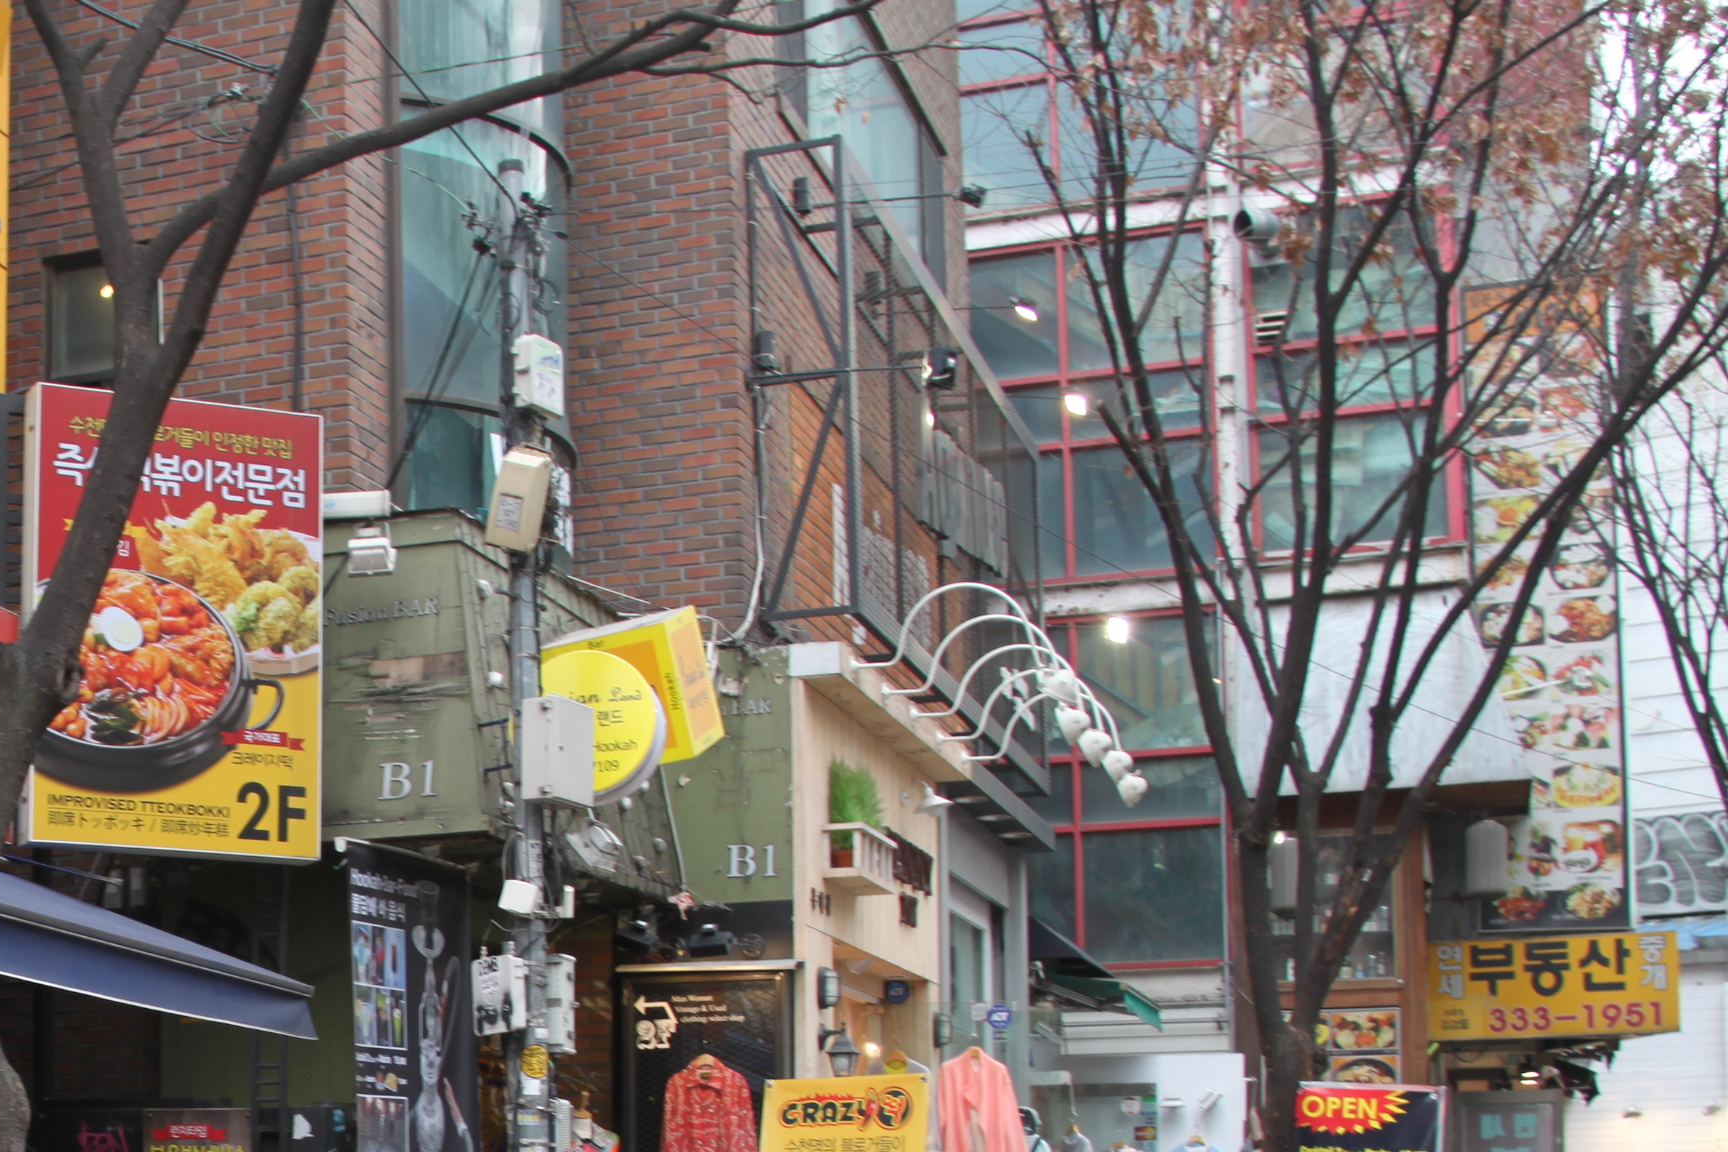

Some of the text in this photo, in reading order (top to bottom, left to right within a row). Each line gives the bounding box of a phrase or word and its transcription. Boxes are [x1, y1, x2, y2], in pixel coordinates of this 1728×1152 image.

[393, 598, 439, 618] BAR
[47, 793, 231, 819] IMPROVISED TTEOKBOKKI
[237, 781, 306, 842] 2F
[1469, 938, 1633, 997] 부동산
[1488, 1001, 1664, 1033] 333-1951
[1302, 1095, 1379, 1120] OPEN
